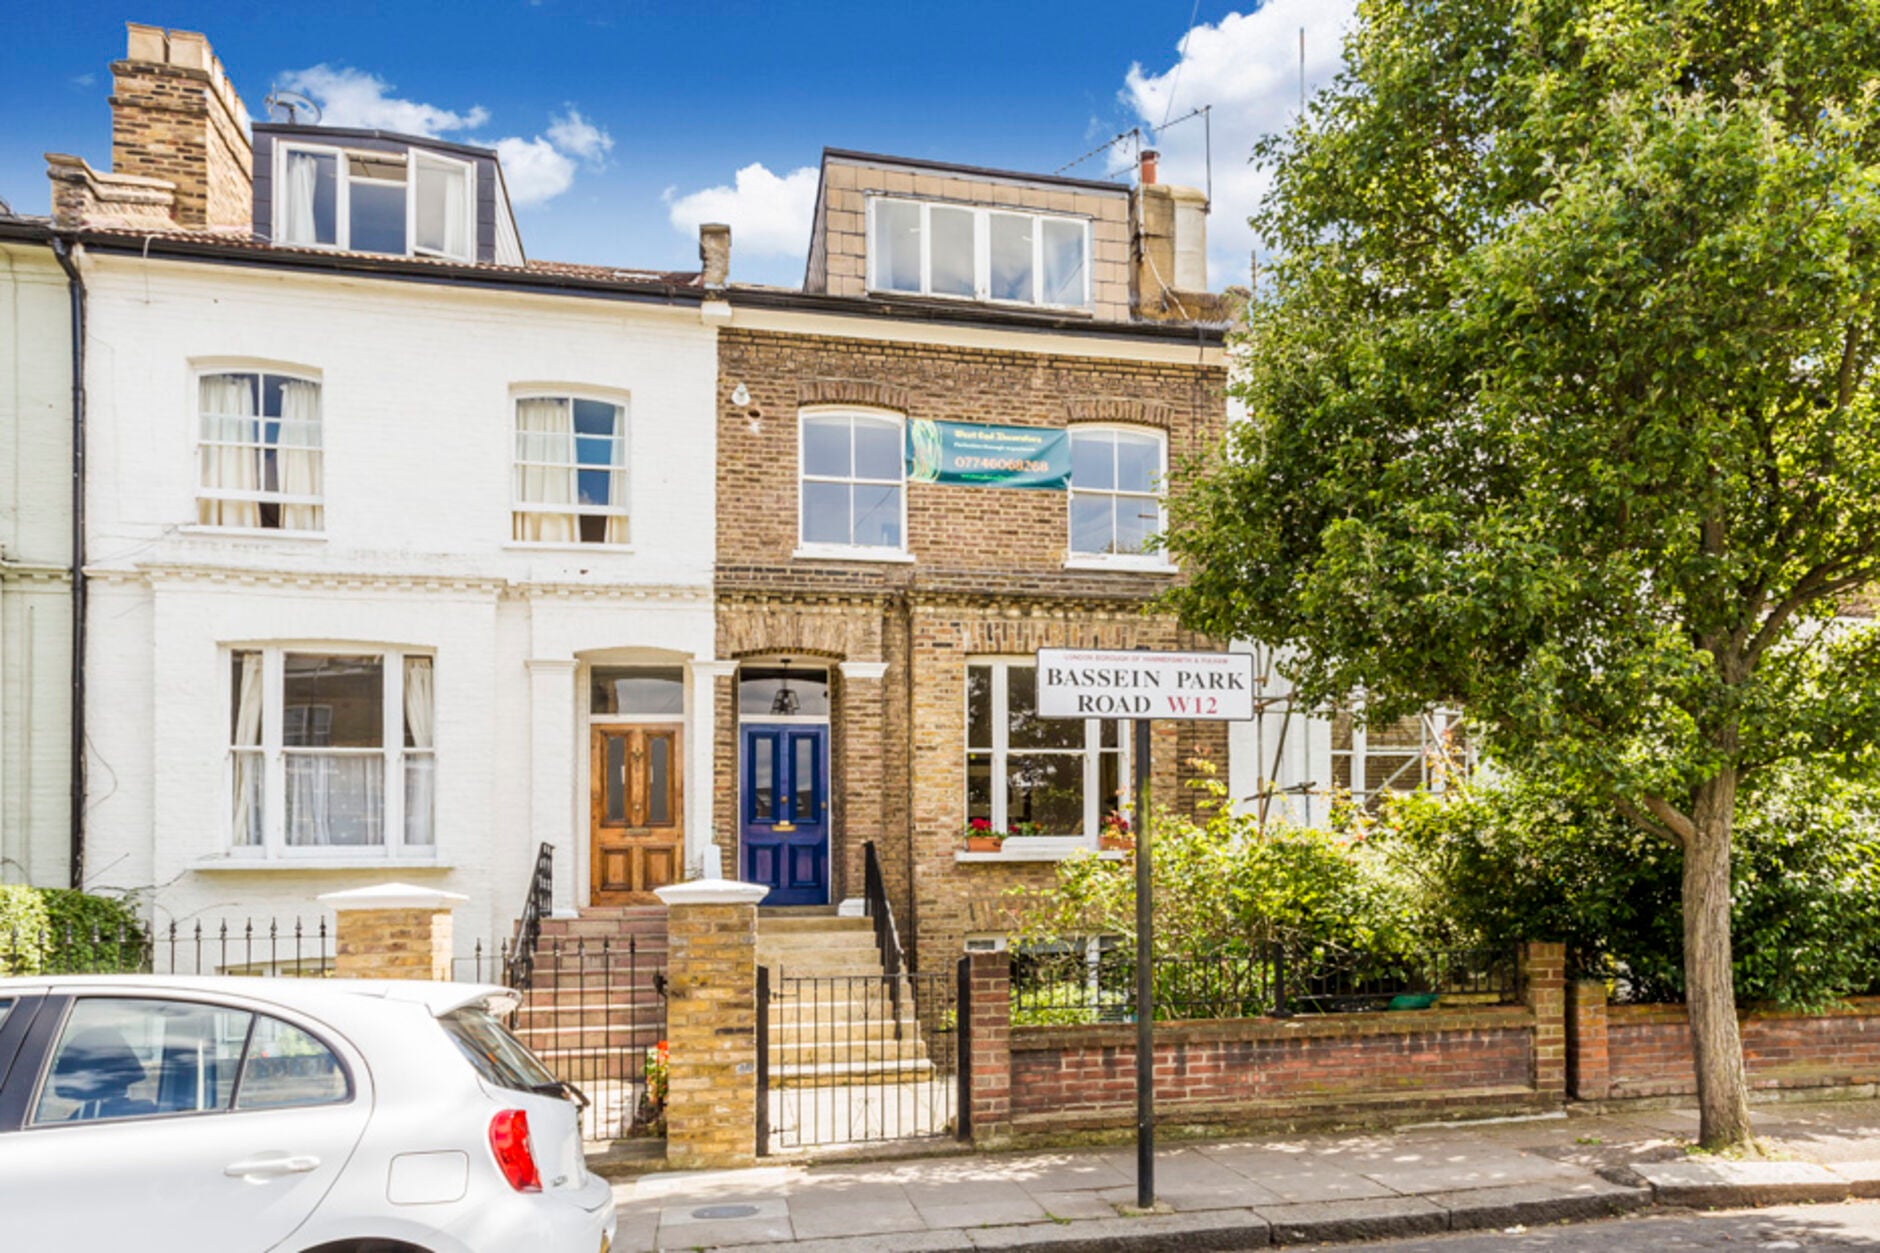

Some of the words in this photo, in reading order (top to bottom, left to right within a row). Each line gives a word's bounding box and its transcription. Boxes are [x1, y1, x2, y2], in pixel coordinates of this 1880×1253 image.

[1047, 667, 1160, 688] BASSEIN
[1177, 671, 1245, 690] PARK
[1078, 694, 1151, 714] ROAD
[1167, 696, 1218, 714] W12
